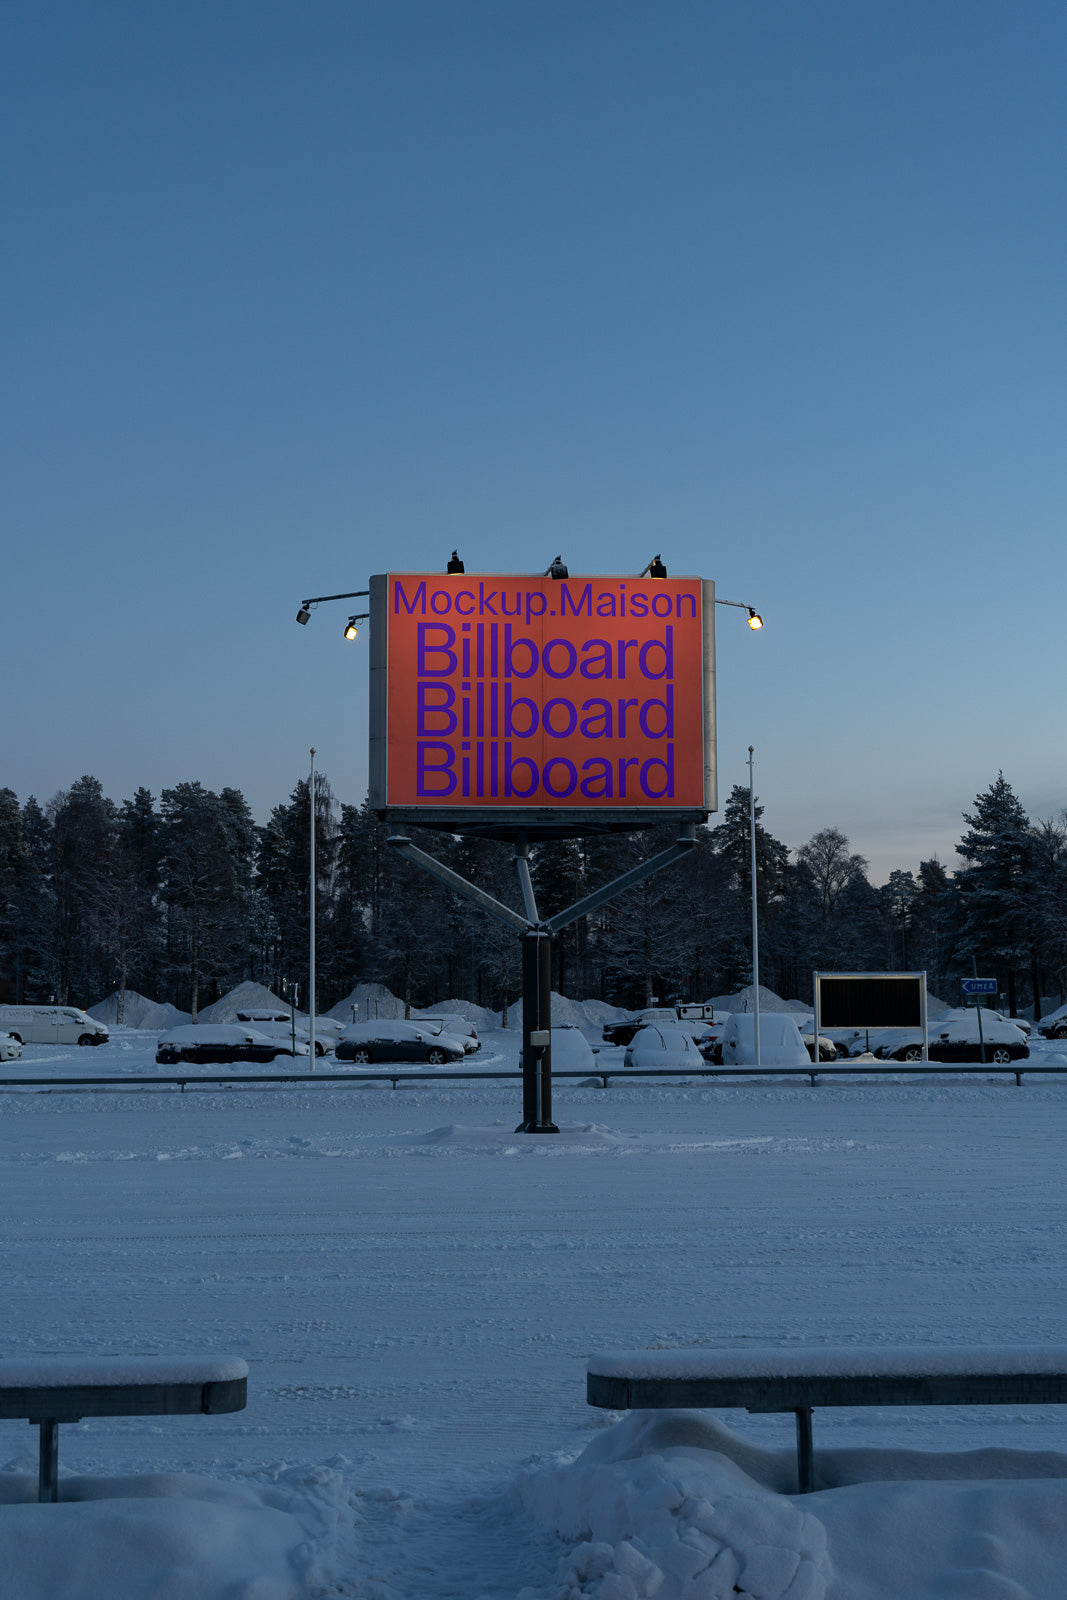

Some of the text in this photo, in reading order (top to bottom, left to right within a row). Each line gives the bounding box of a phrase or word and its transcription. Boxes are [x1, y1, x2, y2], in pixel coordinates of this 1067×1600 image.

[394, 581, 697, 625] Mockup.Maison
[417, 622, 674, 680] Billboard
[417, 681, 674, 739] Billboard
[416, 741, 675, 798] Billboard
[971, 982, 994, 990] UMEÅ
